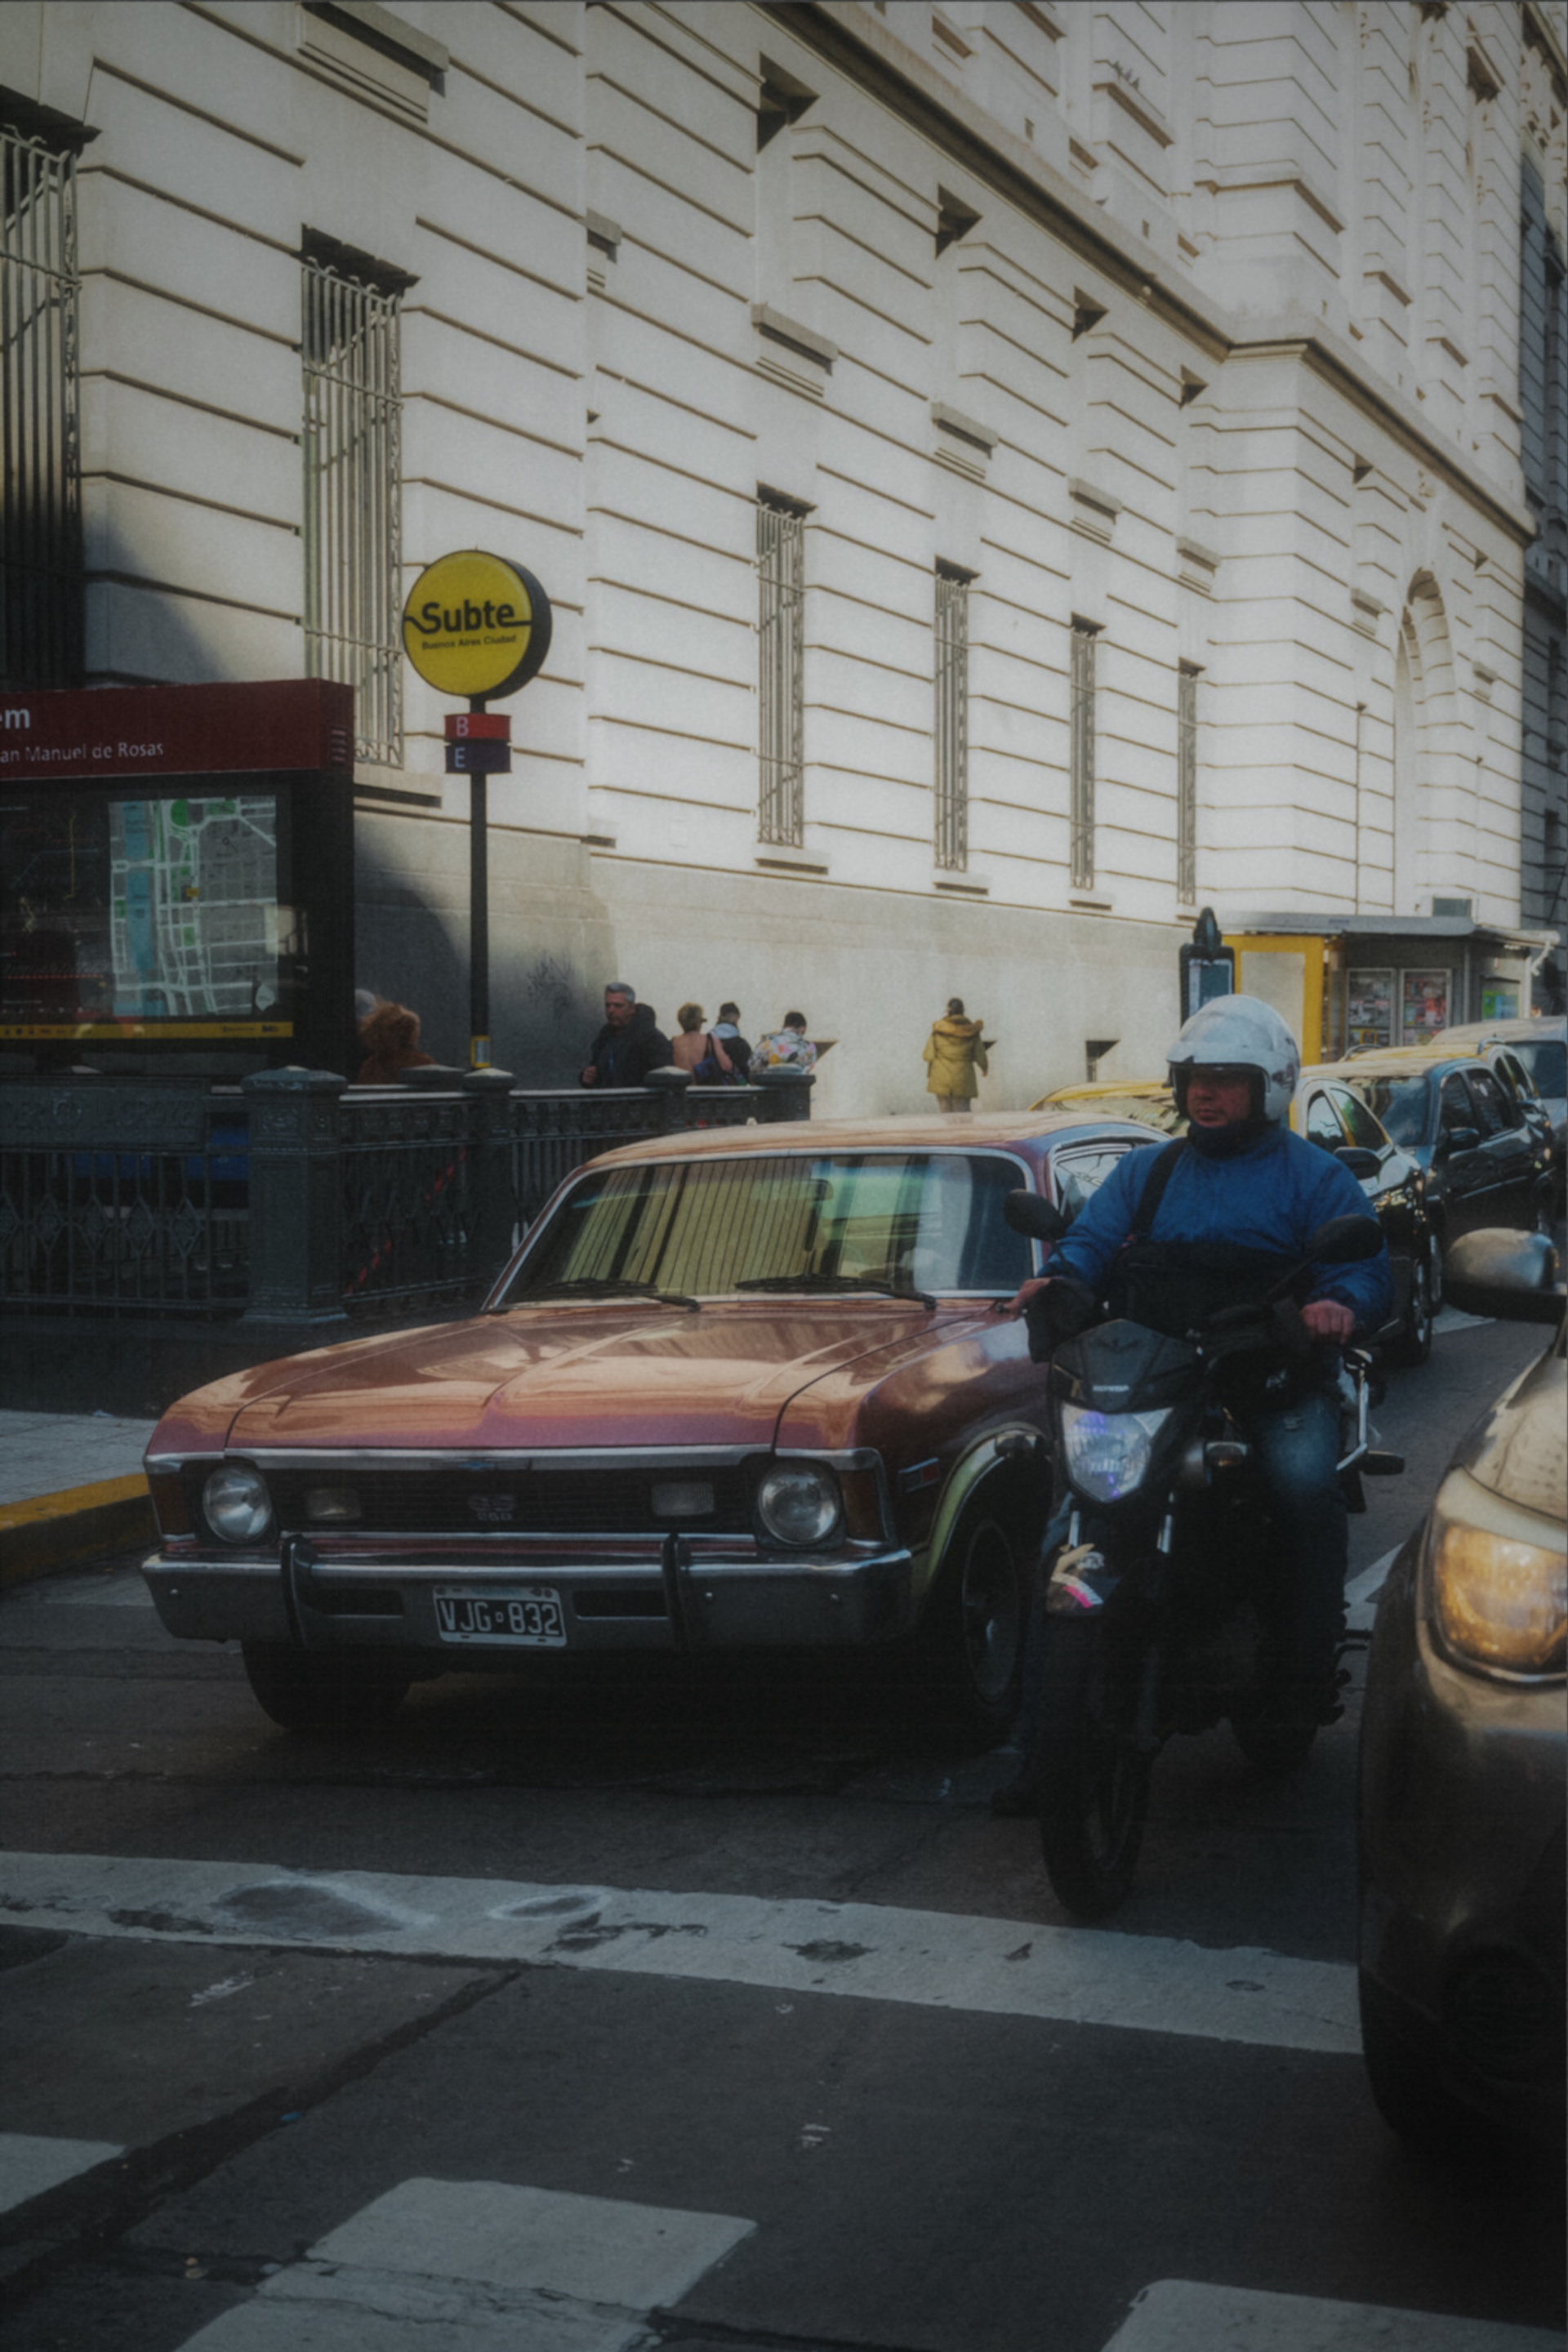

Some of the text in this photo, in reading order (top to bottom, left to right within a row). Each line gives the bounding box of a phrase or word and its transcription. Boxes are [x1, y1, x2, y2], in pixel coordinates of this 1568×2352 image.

[415, 599, 524, 635] Subte
[421, 634, 516, 651] Buenos Aires Ciudad
[0, 707, 31, 729] m
[456, 715, 469, 737] B
[24, 742, 87, 762] Manuel
[91, 742, 113, 760] de
[117, 742, 165, 758] Rosas
[454, 746, 466, 769] E
